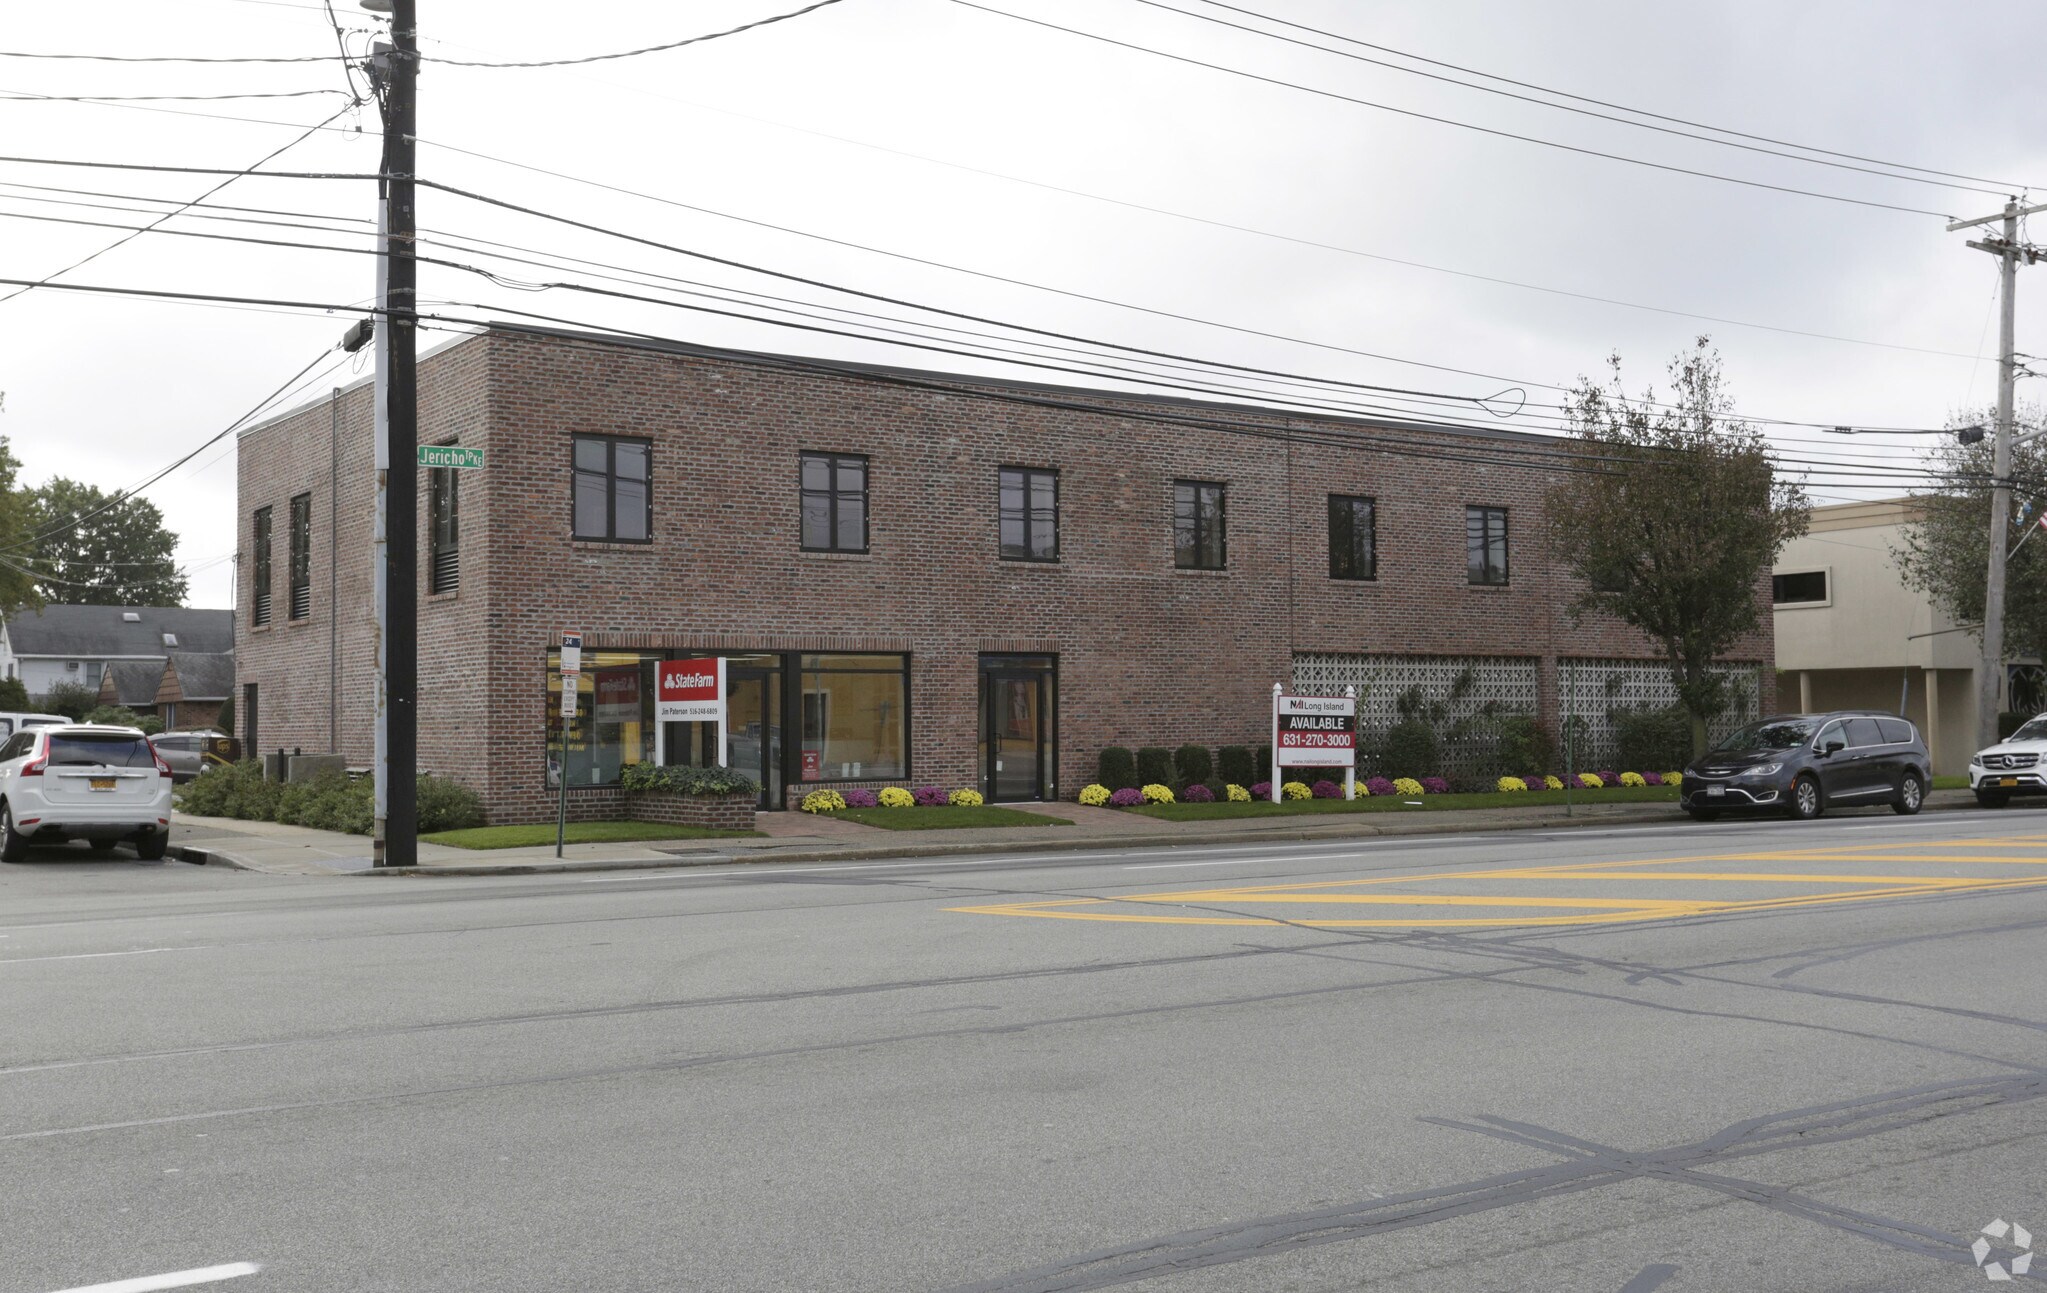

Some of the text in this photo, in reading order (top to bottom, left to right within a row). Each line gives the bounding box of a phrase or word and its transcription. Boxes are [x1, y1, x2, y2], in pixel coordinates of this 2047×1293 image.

[420, 448, 482, 467] Jericho TPKE
[1290, 699, 1345, 712] NAI Long Island
[1290, 716, 1345, 730] AVAILABLE
[1283, 733, 1351, 746] 631-270-3000
